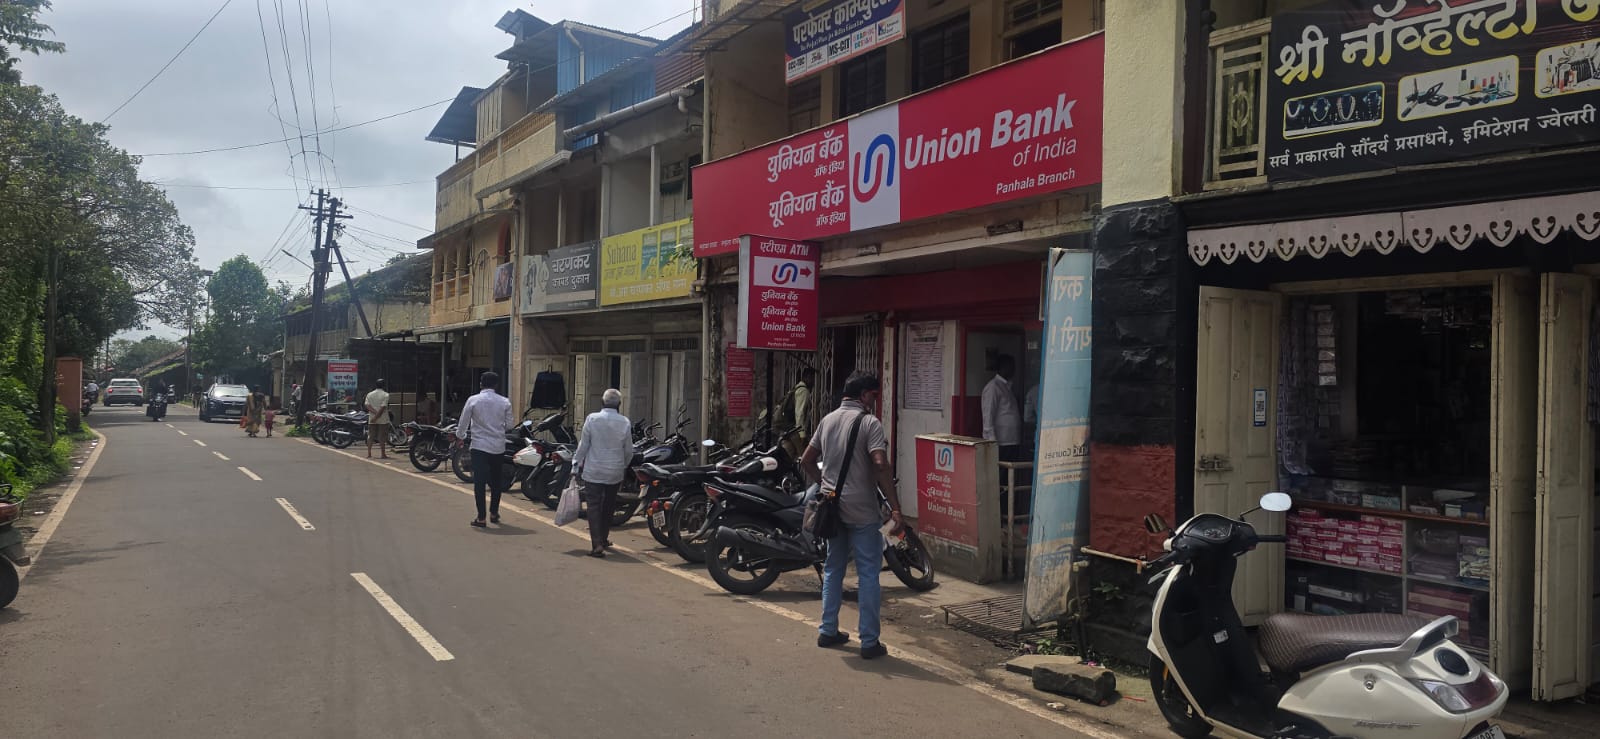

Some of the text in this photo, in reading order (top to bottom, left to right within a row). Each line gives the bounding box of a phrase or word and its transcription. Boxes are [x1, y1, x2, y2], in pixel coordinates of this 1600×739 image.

[793, 8, 833, 44] परफेक्ट
[1274, 25, 1329, 85] श्री
[904, 92, 1078, 170] Union Bank
[1269, 104, 1598, 168] सर्व प्रकारची सौंदर्य प्रसाधने, इमिटेशन ज्वेलरी
[768, 129, 845, 182] युनियन बँक
[1013, 136, 1077, 167] of India
[814, 160, 846, 178] ऑफ इंडिया
[996, 167, 1076, 195] Panhala Branch
[769, 180, 846, 228] यूनियन बैंक
[816, 211, 846, 227] ऑफ इंडिया
[607, 241, 637, 266] Suhana
[760, 240, 809, 256] एटीएम ATM
[571, 273, 590, 290] दुकान
[761, 321, 806, 333] Union Bank
[927, 501, 967, 519] Union Bank
